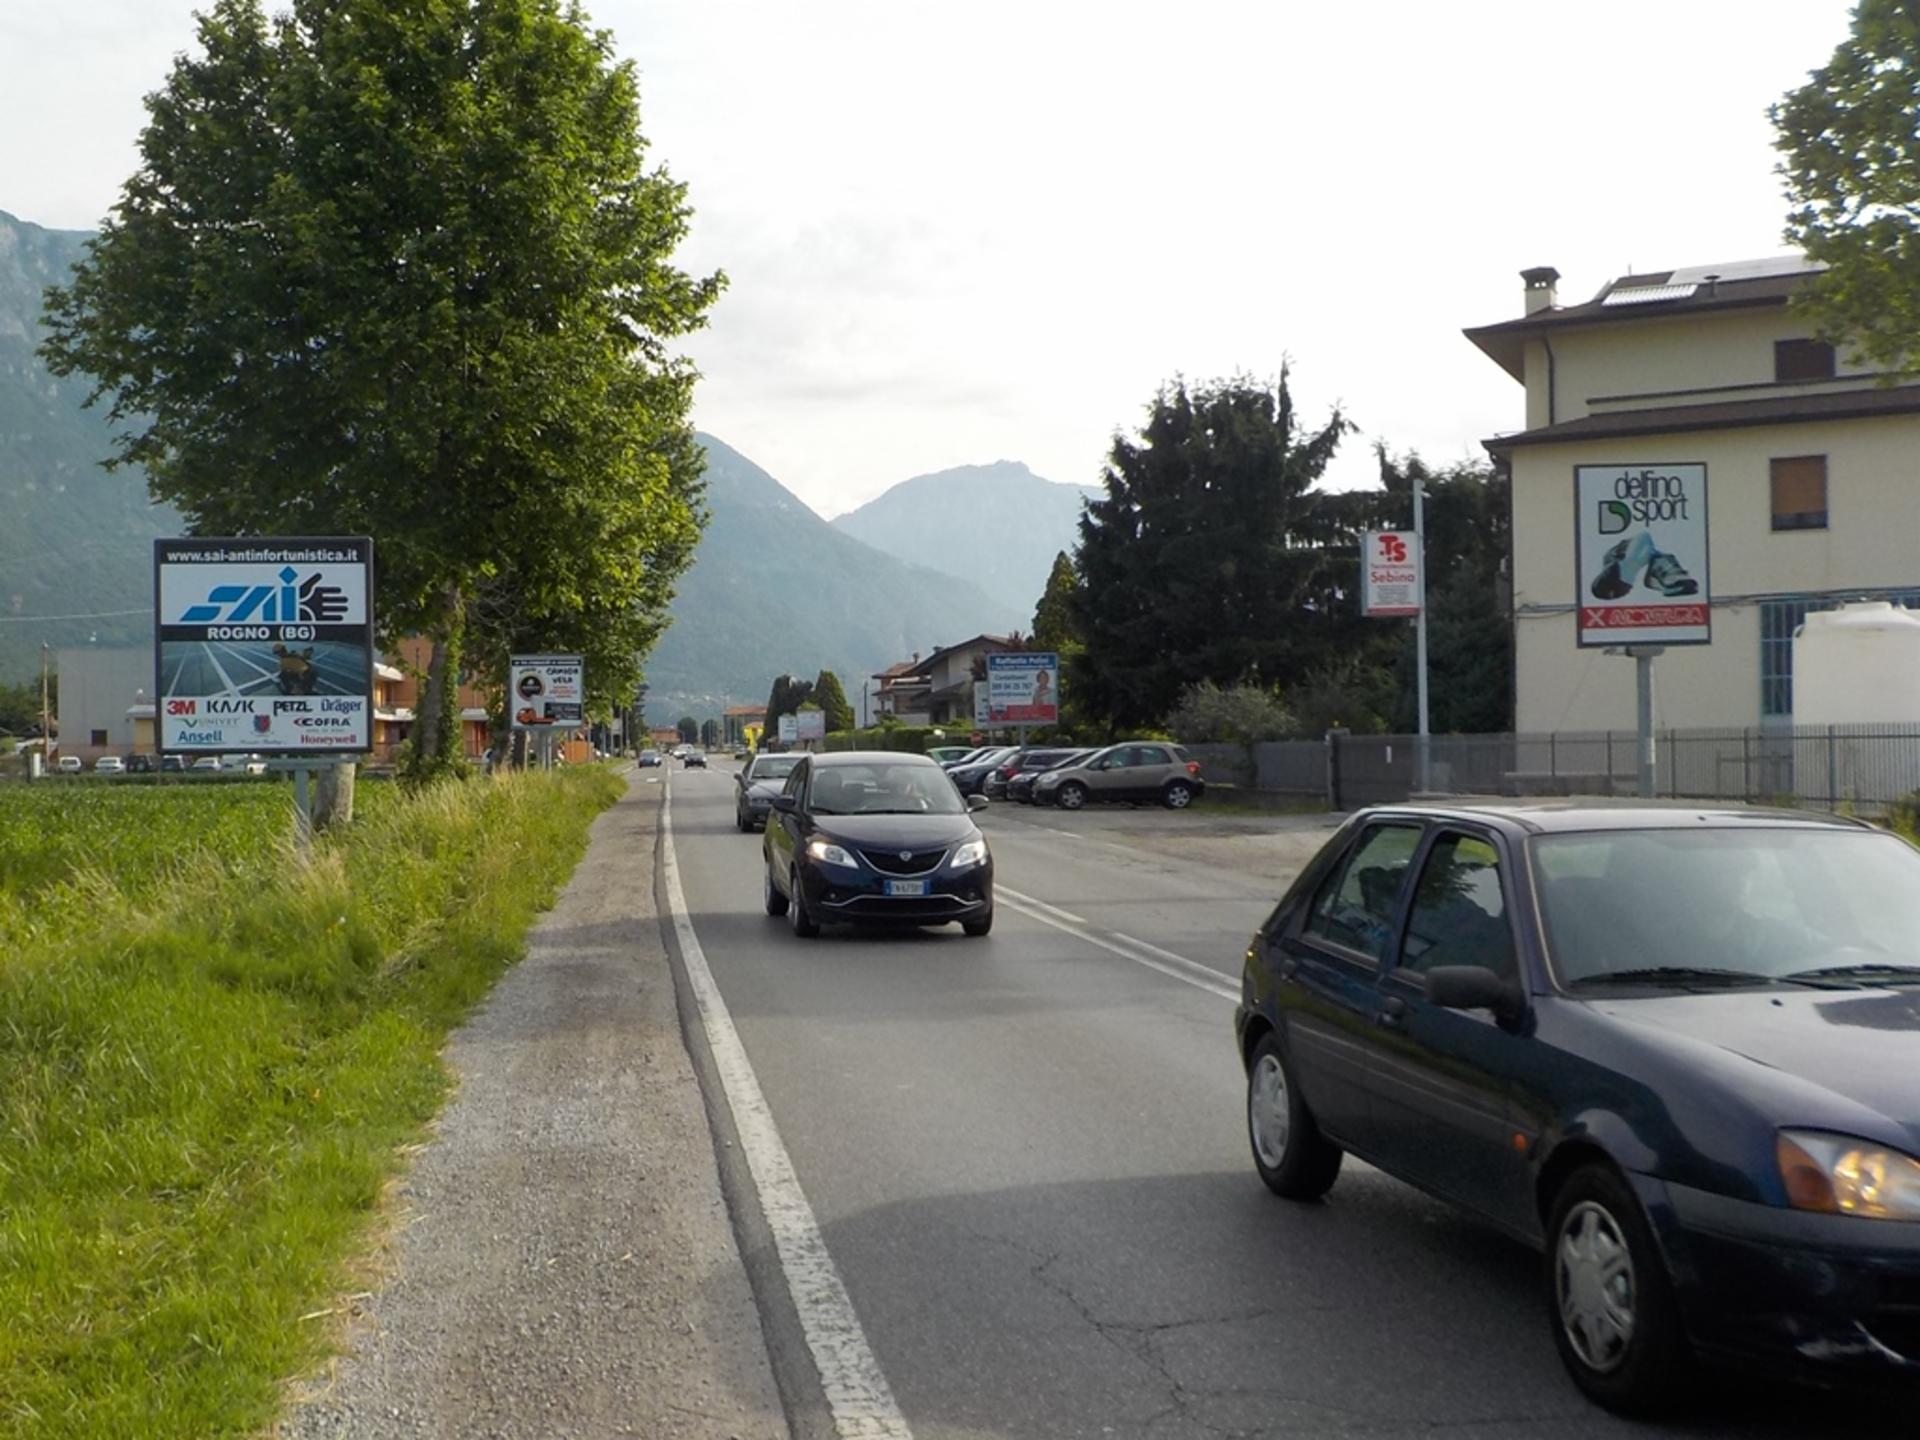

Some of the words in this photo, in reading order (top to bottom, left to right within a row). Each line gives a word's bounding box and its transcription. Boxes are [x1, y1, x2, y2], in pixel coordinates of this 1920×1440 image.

[1614, 470, 1682, 499] delfino
[1632, 492, 1689, 527] sport
[167, 549, 358, 562] www.sai-antinfortunistica.it
[207, 627, 270, 640] ROGNO
[279, 626, 316, 641] (BG)
[167, 701, 196, 715] 3M
[206, 700, 254, 714] KASK
[273, 701, 313, 717] PETZL
[321, 699, 361, 714] Dräger
[302, 718, 351, 727] COFRA
[178, 730, 222, 742] Ansell
[301, 734, 357, 745] Honeywell
